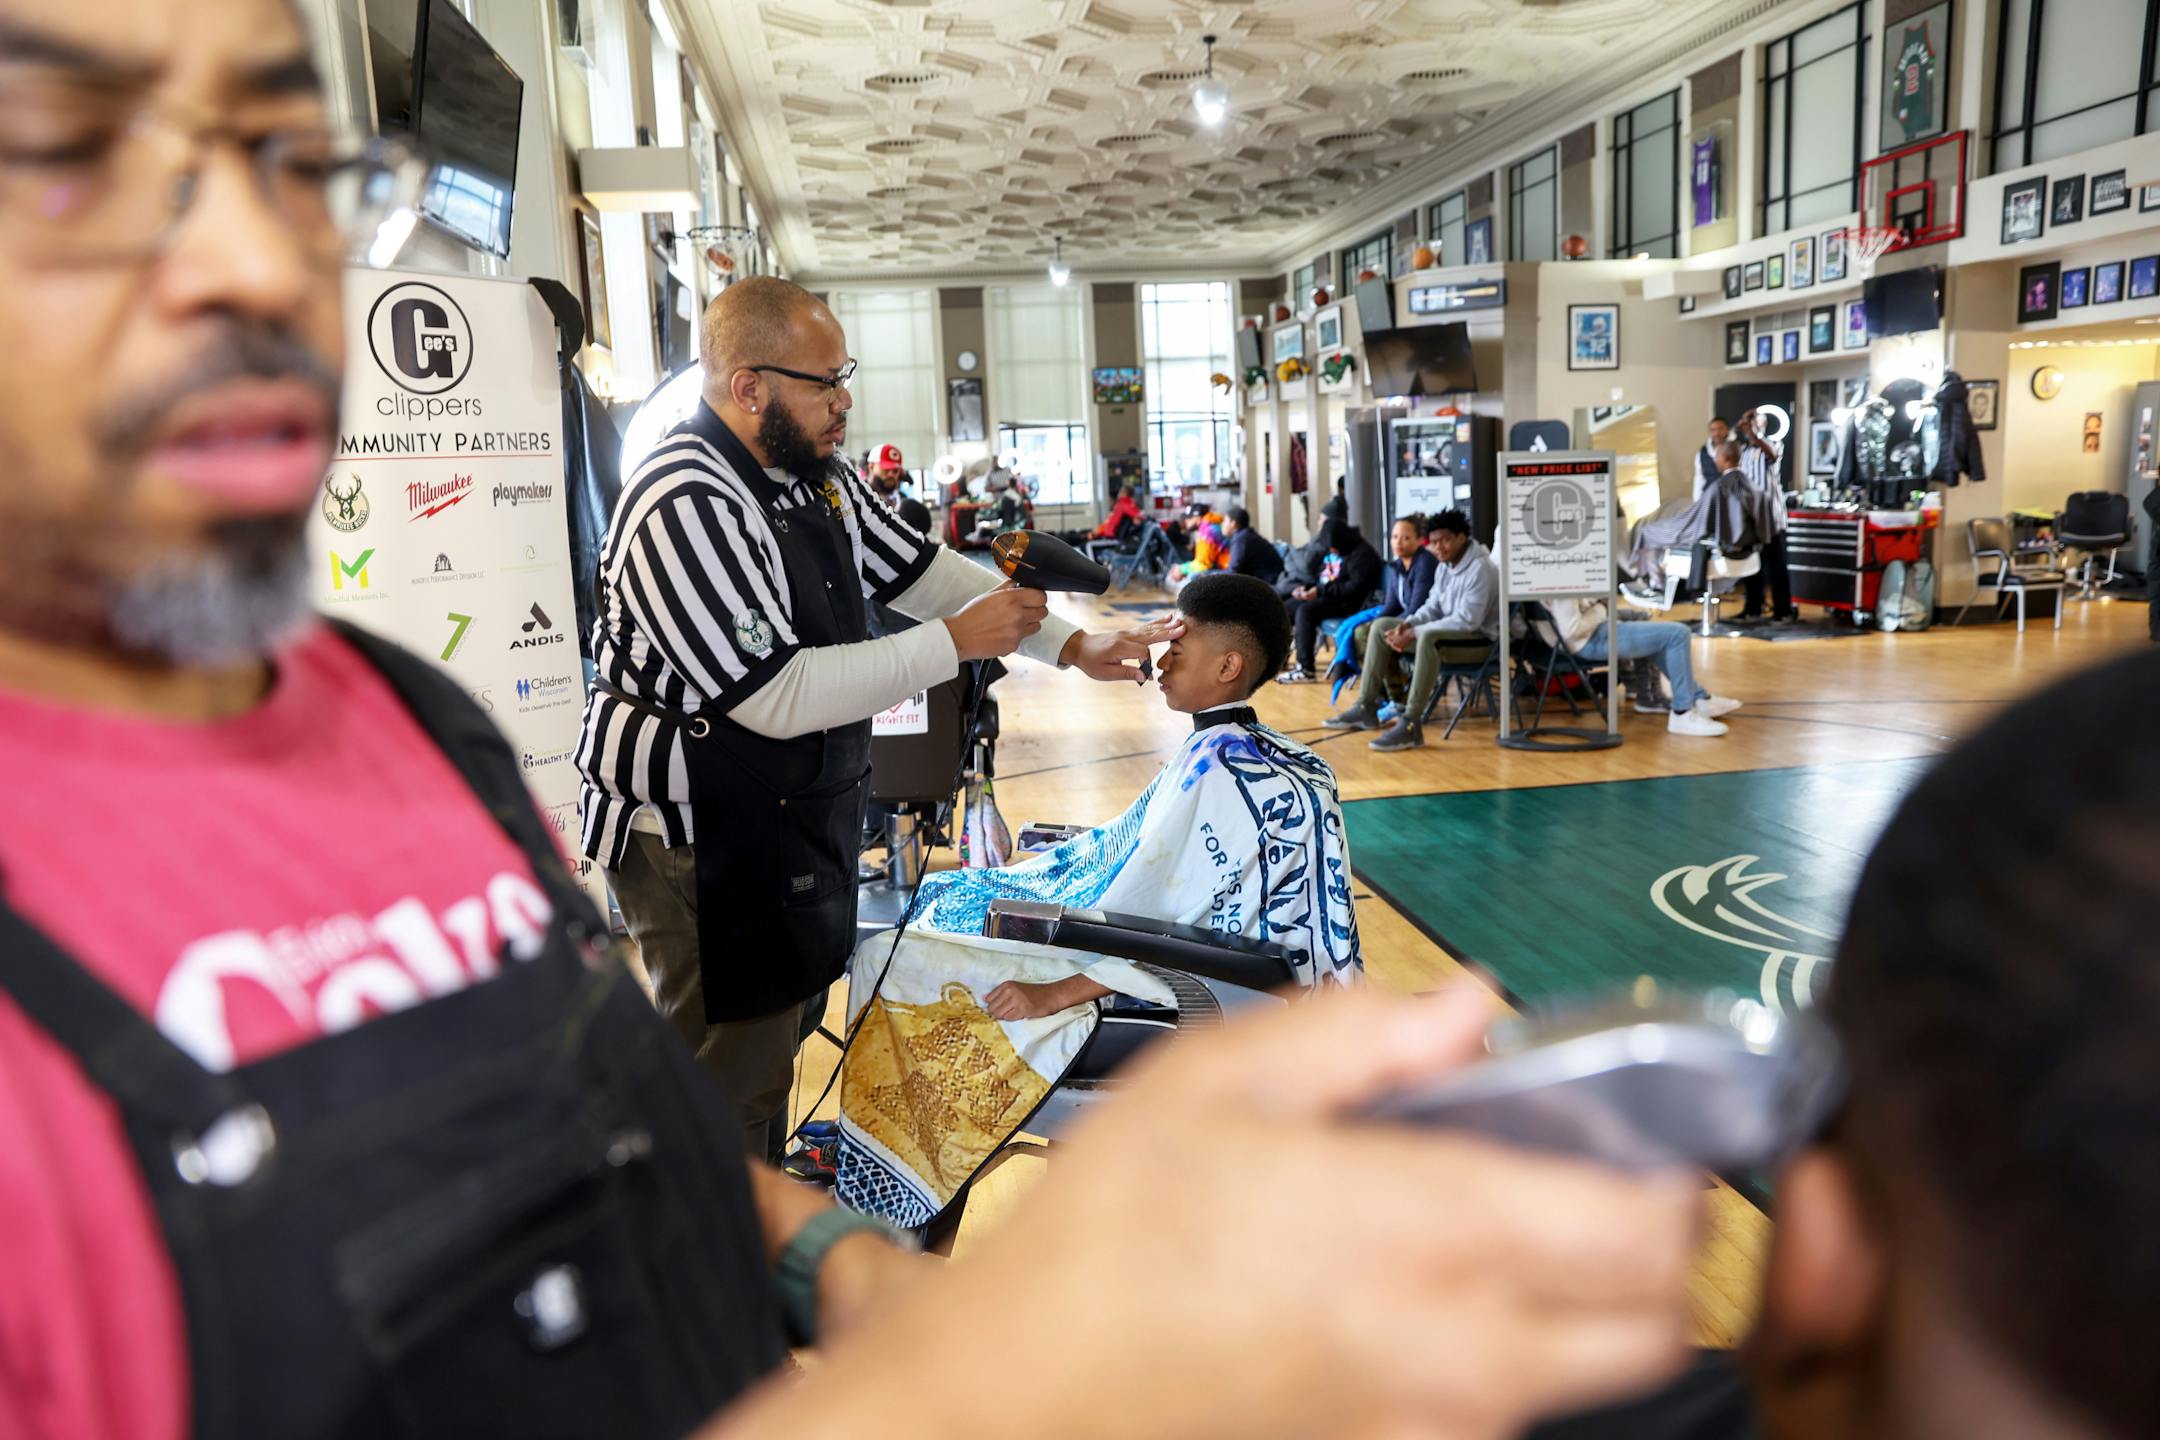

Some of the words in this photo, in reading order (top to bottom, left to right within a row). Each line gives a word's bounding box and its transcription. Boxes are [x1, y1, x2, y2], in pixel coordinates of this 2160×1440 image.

[376, 392, 482, 421] clippers
[455, 432, 551, 451] PARTNERS
[1541, 464, 1573, 474] PRICE
[404, 474, 474, 512] Milwaukee
[440, 612, 472, 662] 7
[509, 633, 565, 650] ANDIS
[531, 675, 572, 690] Children's
[876, 715, 904, 724] RIGHT
[906, 714, 920, 724] FIT
[534, 753, 563, 767] HEALTHY
[1200, 822, 1228, 867] FOR
